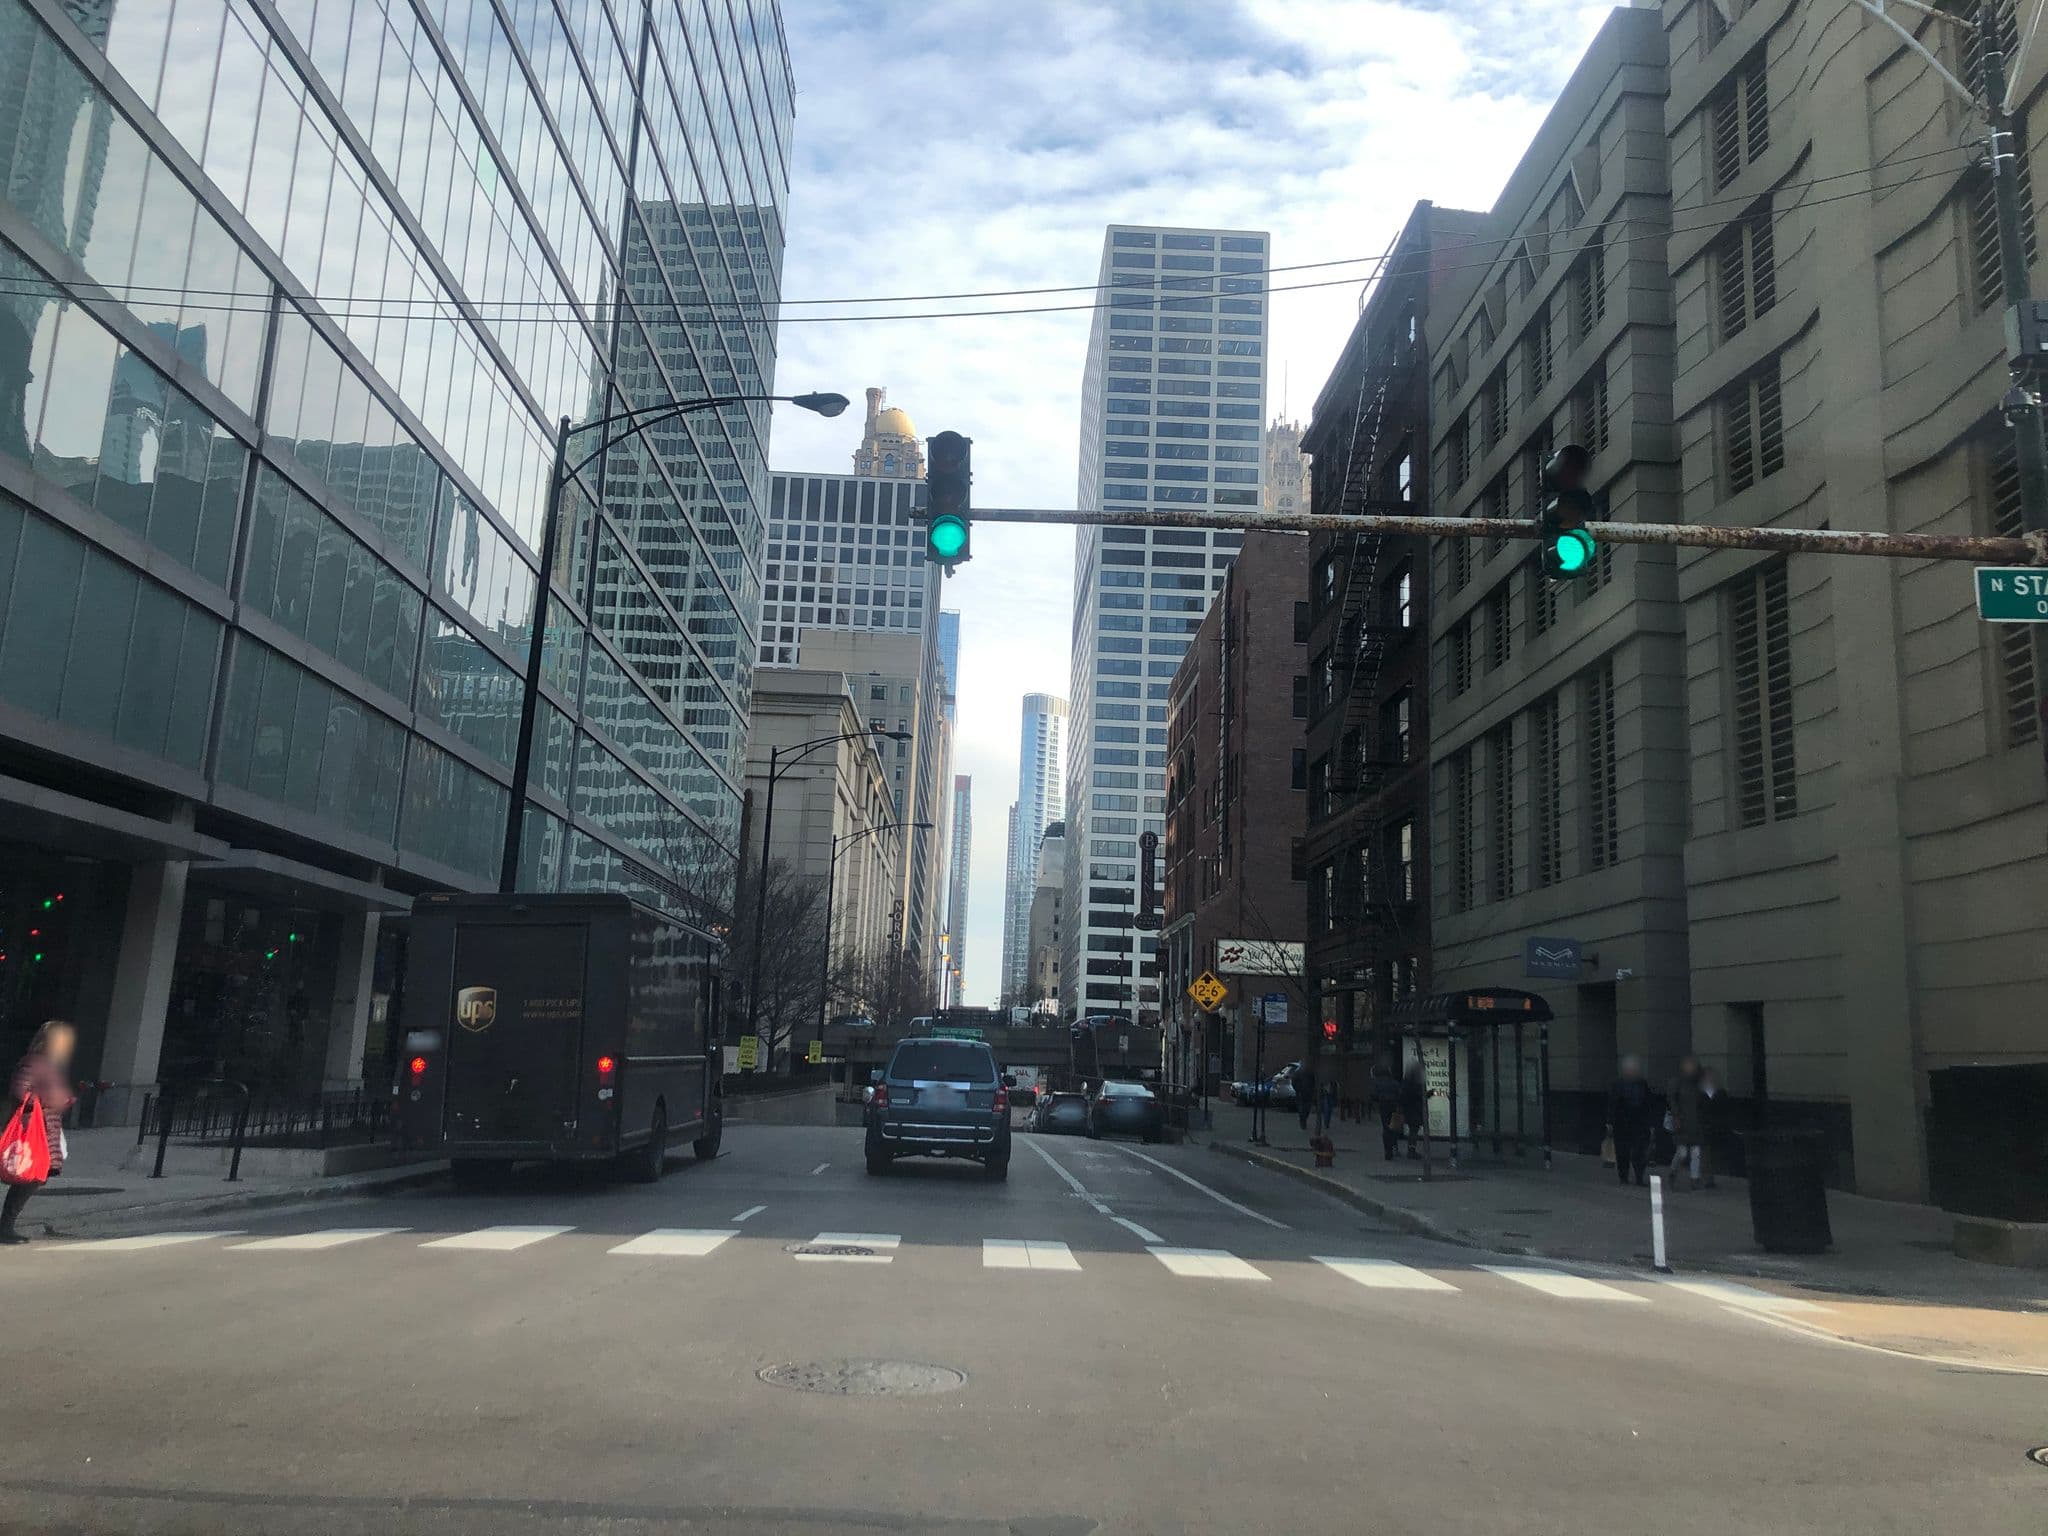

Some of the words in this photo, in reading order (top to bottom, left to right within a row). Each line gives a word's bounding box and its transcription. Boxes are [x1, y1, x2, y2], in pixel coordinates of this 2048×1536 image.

[1991, 578, 2003, 591] N
[460, 1000, 494, 1025] ups
[1411, 1047, 1429, 1058] Te
